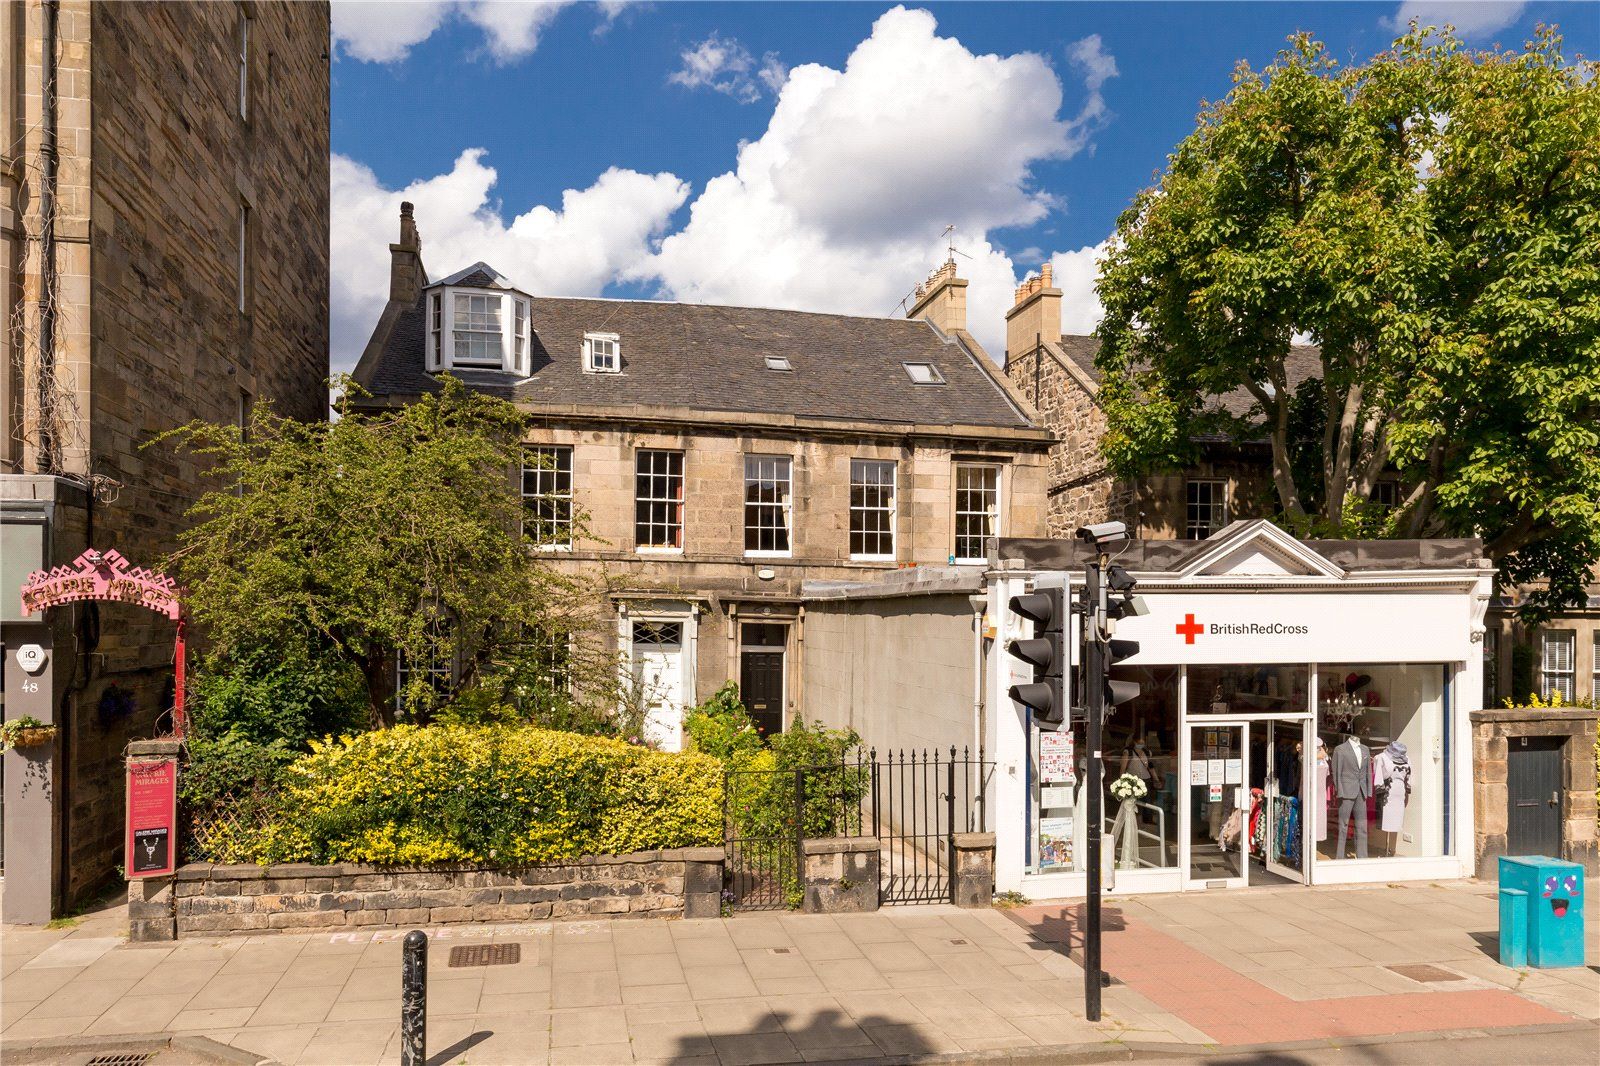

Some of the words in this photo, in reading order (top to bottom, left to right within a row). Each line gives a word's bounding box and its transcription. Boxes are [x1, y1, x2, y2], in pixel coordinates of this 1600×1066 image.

[31, 577, 95, 601] GALERIE
[25, 650, 36, 659] iQ
[21, 679, 39, 693] 48
[135, 777, 169, 786] MIRAGES
